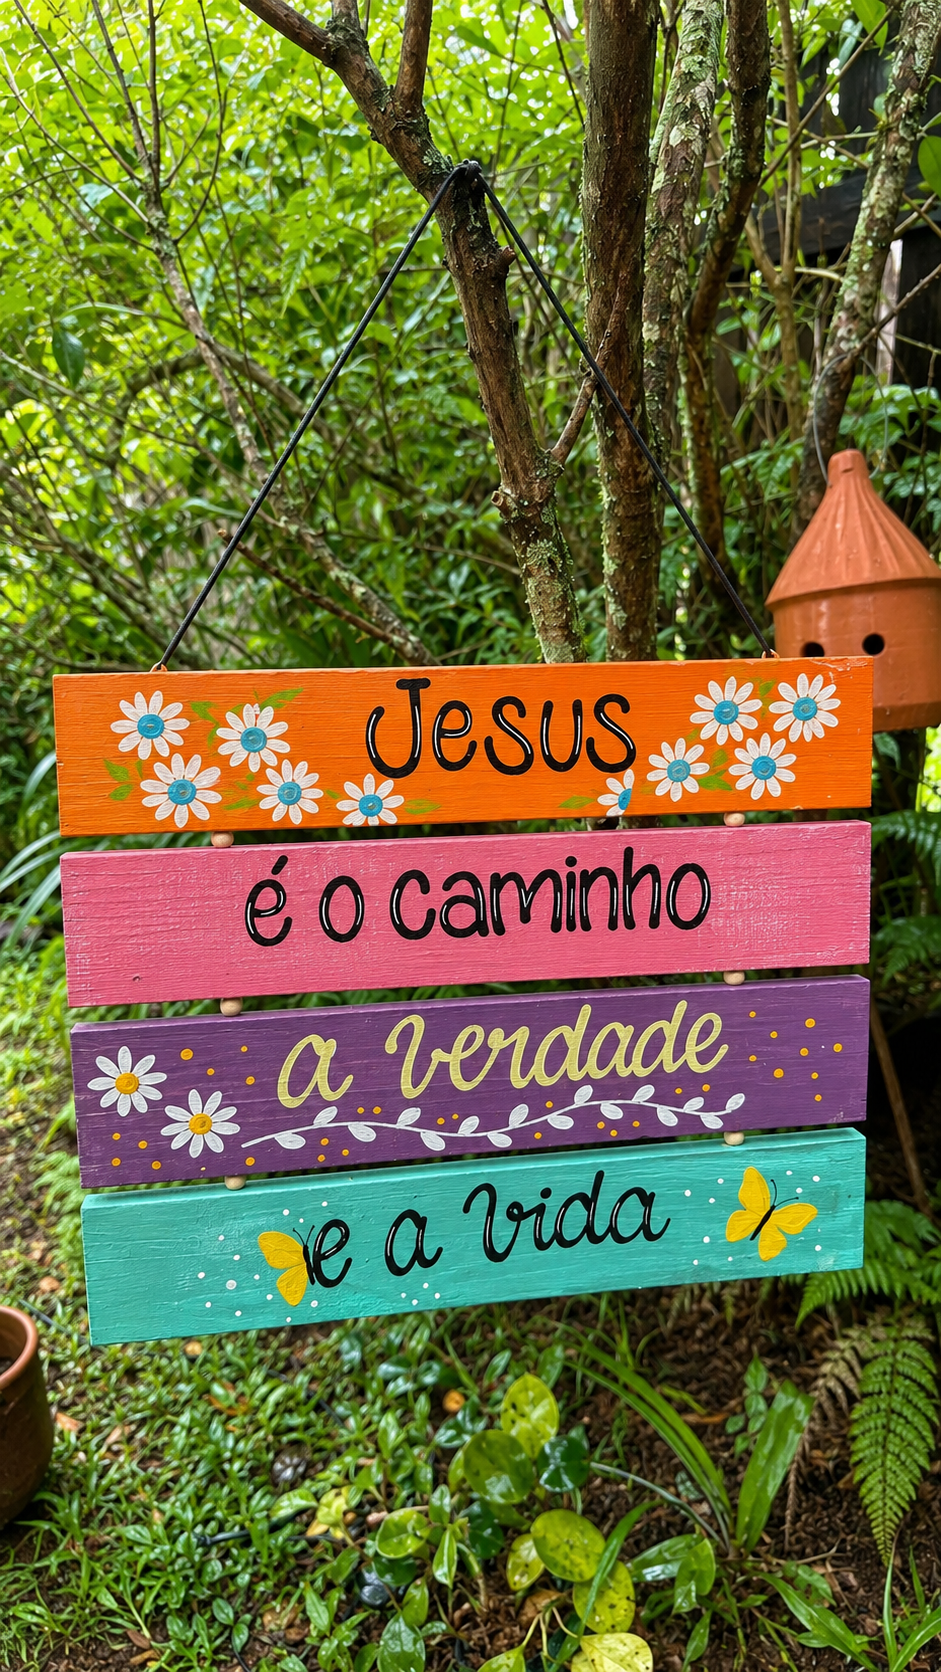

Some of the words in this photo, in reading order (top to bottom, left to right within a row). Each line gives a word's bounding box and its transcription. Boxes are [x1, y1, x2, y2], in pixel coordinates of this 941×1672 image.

[366, 677, 637, 779] Jesus
[244, 855, 293, 947] é
[318, 875, 365, 943] o
[389, 846, 712, 940] caminho
[276, 1033, 354, 1109] a
[312, 1218, 353, 1288] e
[384, 1208, 444, 1277] a
